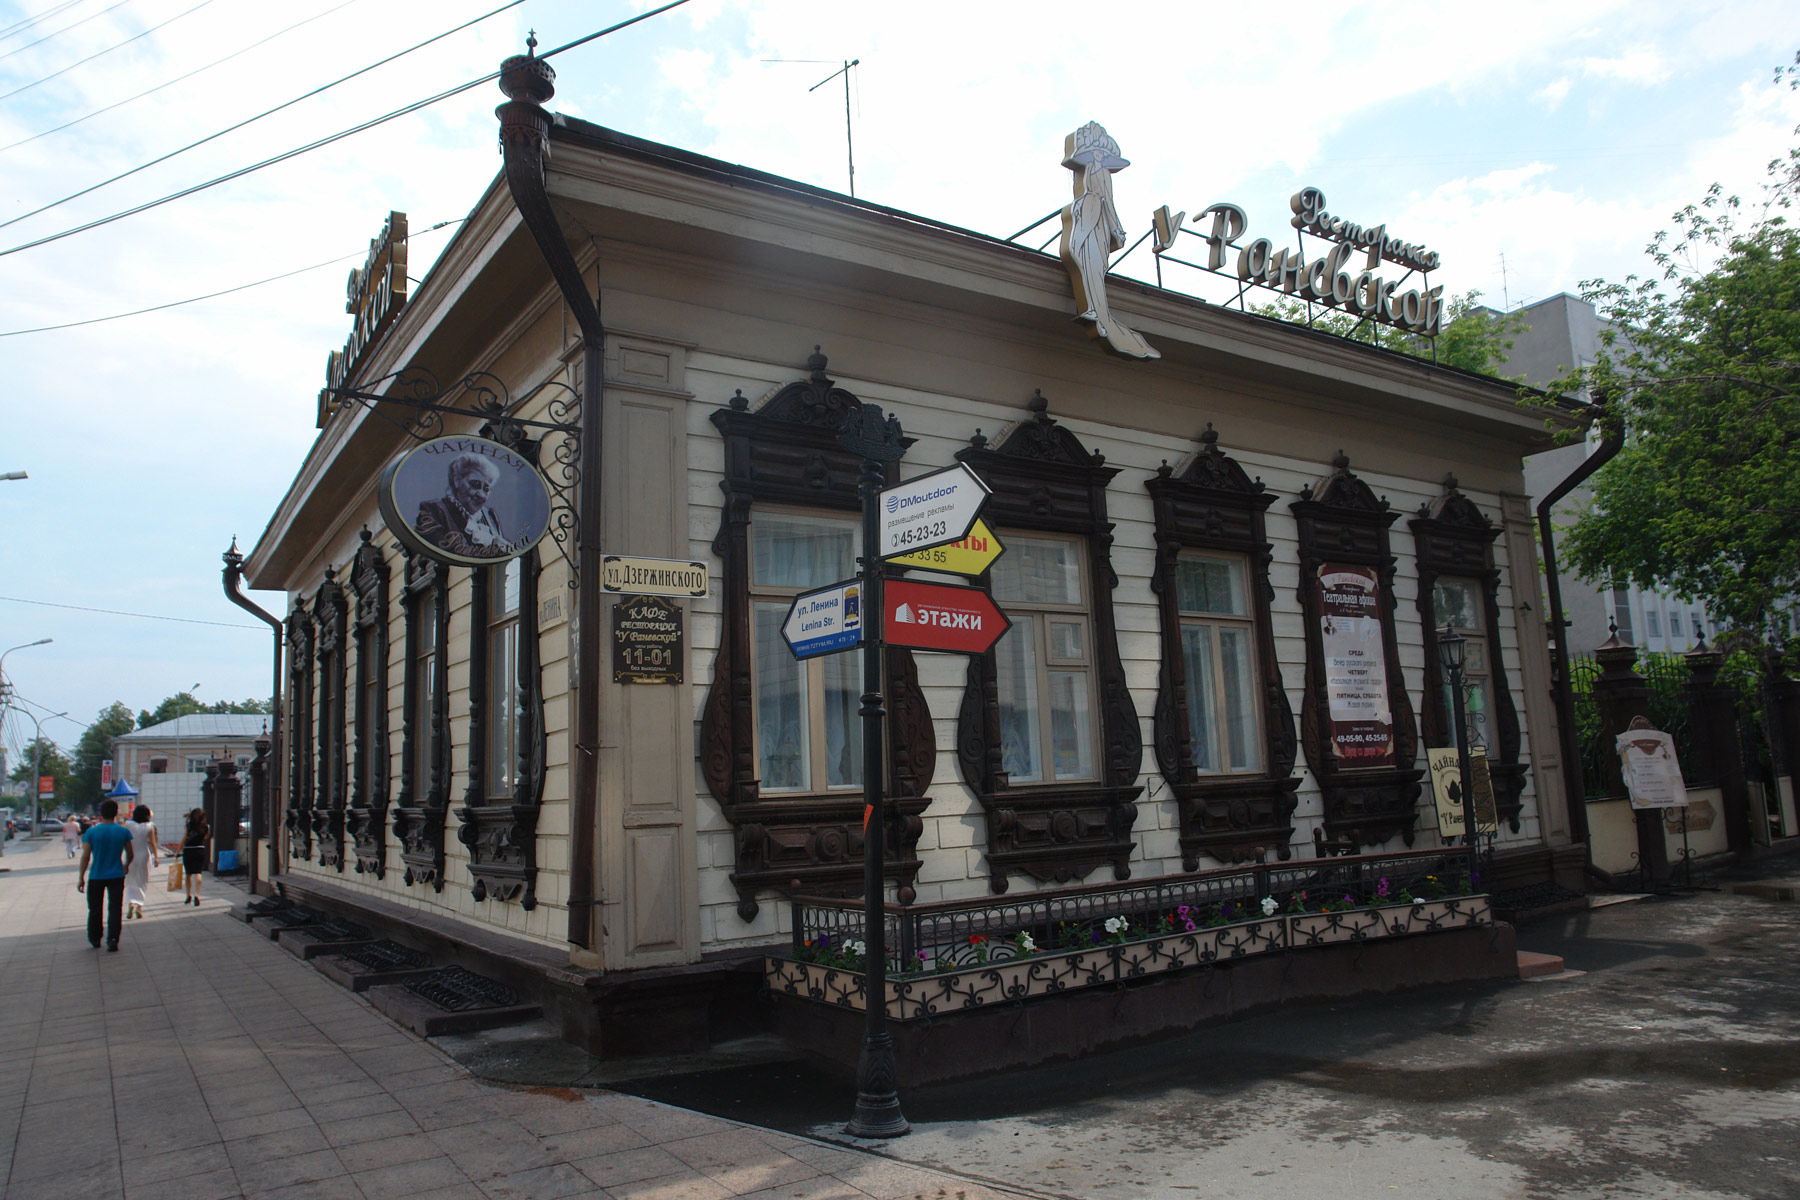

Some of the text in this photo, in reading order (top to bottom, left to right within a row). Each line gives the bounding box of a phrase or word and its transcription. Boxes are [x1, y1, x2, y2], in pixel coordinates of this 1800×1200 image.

[1290, 187, 1440, 272] Ресторация
[1192, 202, 1445, 336] Раневской
[424, 439, 525, 473] ЧАЙНАЯ
[900, 484, 958, 509] DMoutdoor
[887, 503, 955, 530] размещение рекламы
[900, 520, 946, 545] 45-23-23
[934, 551, 947, 562] 55
[797, 597, 839, 619] ул. Ленина
[1322, 590, 1376, 608] Театральная афиша
[628, 606, 668, 621] КАФЕ
[801, 617, 835, 632] Lenina Str.
[917, 609, 982, 631] этажи
[622, 648, 671, 665] 11-01
[1432, 755, 1461, 772] ЧАЙНА
